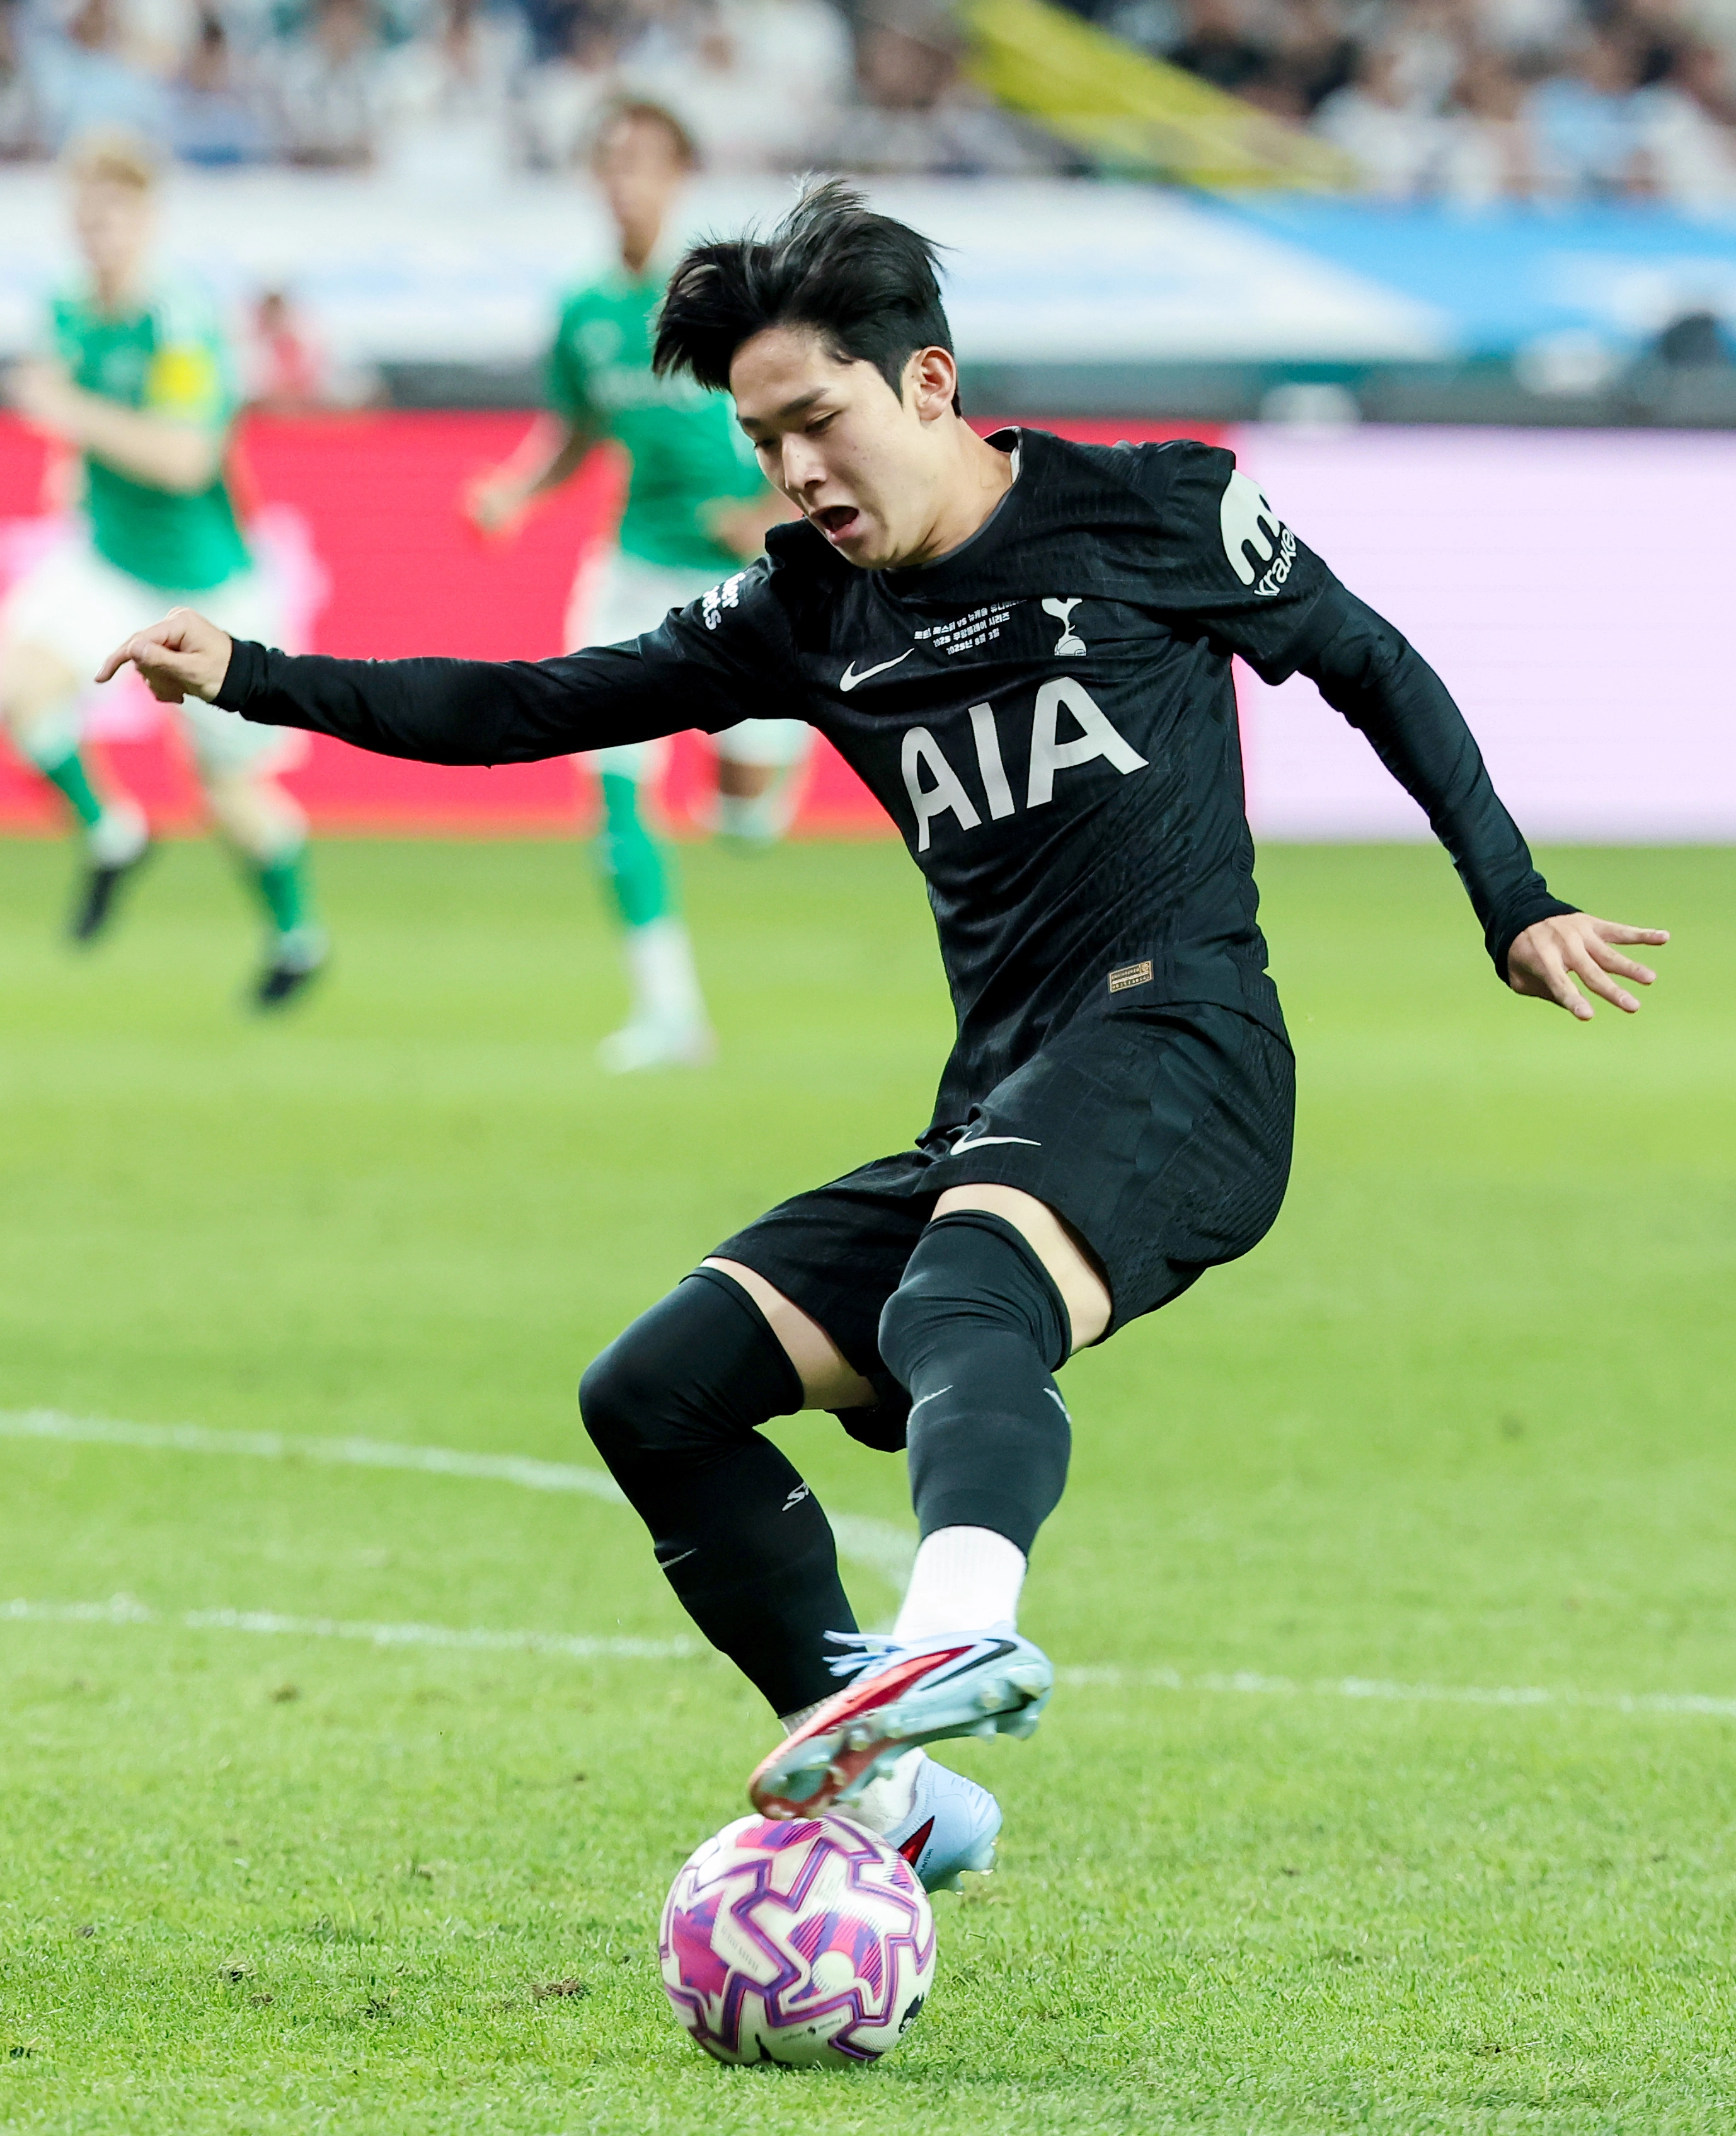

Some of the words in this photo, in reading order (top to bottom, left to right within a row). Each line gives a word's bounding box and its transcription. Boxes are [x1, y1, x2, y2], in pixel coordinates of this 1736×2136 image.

[1253, 527, 1297, 596] krake
[933, 635, 951, 648] 2025
[988, 611, 1010, 626] 시리즈
[901, 676, 1150, 853] AIA
